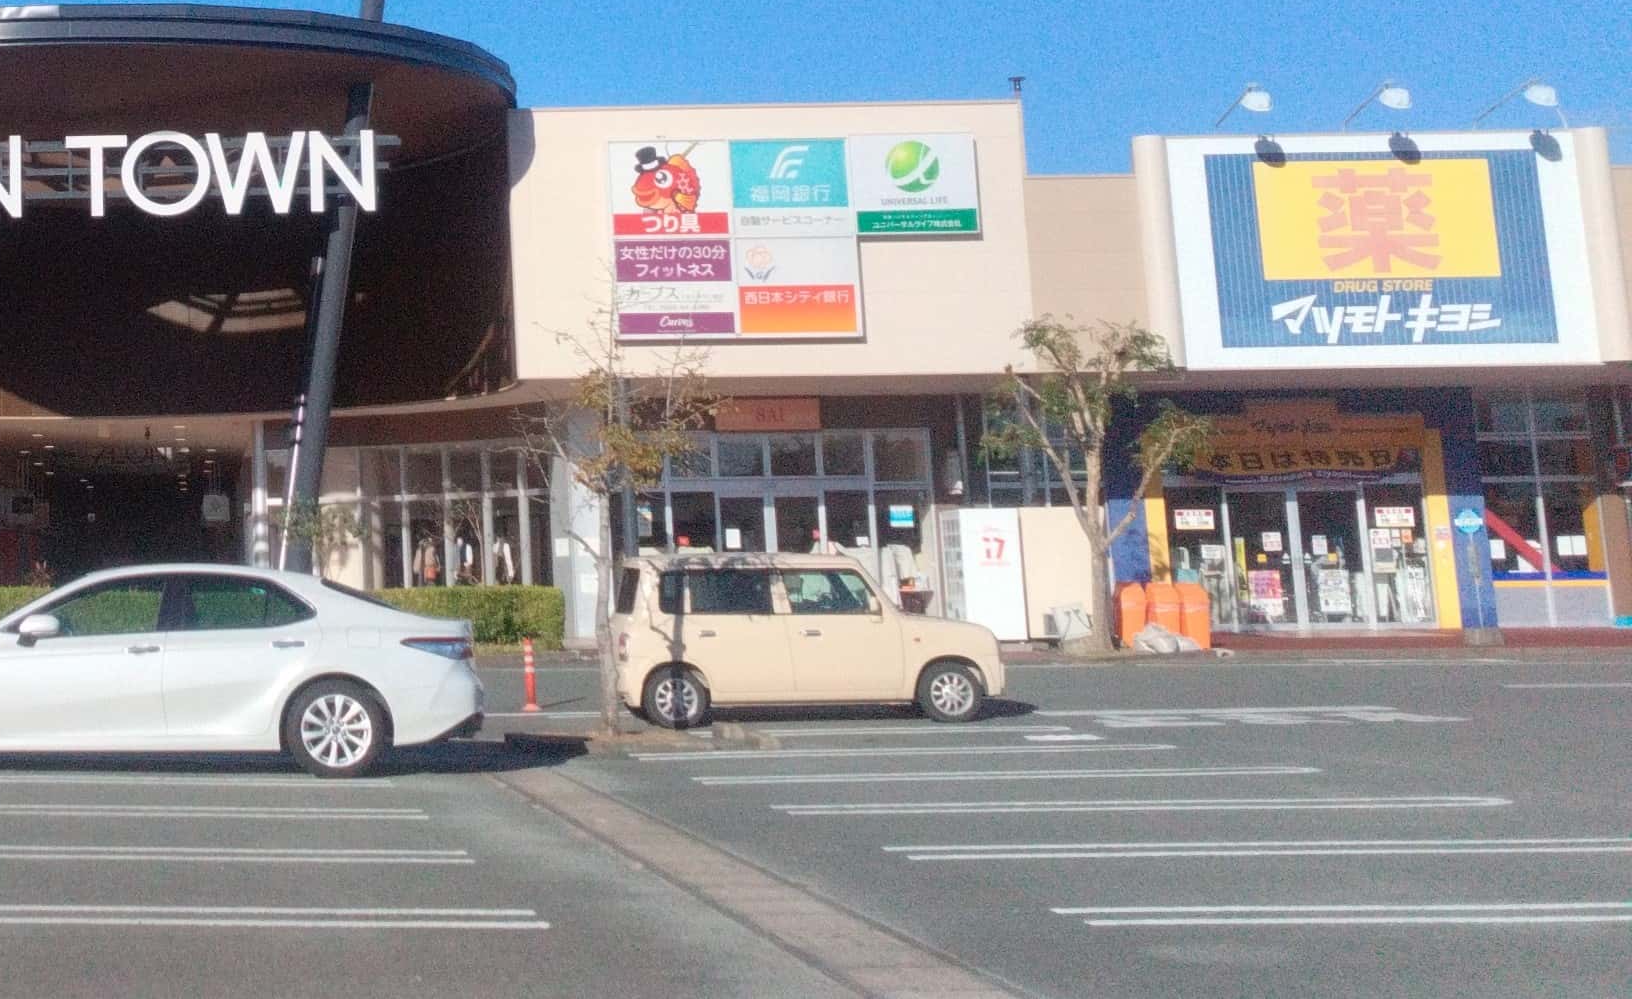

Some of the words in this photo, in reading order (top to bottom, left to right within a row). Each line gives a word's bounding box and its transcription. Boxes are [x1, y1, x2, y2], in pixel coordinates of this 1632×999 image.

[65, 129, 377, 217] TOWN
[751, 184, 831, 202] 福岡銀行
[641, 213, 701, 233] つり具
[1311, 167, 1443, 273] 薬
[620, 246, 727, 260] 女性だけの30分
[634, 263, 715, 278] フィットネス
[1334, 280, 1378, 294] DRUG
[1382, 279, 1433, 292] STORE
[744, 290, 849, 305] 西日本シティ銀行
[1271, 294, 1502, 344] マツモトキヨシ
